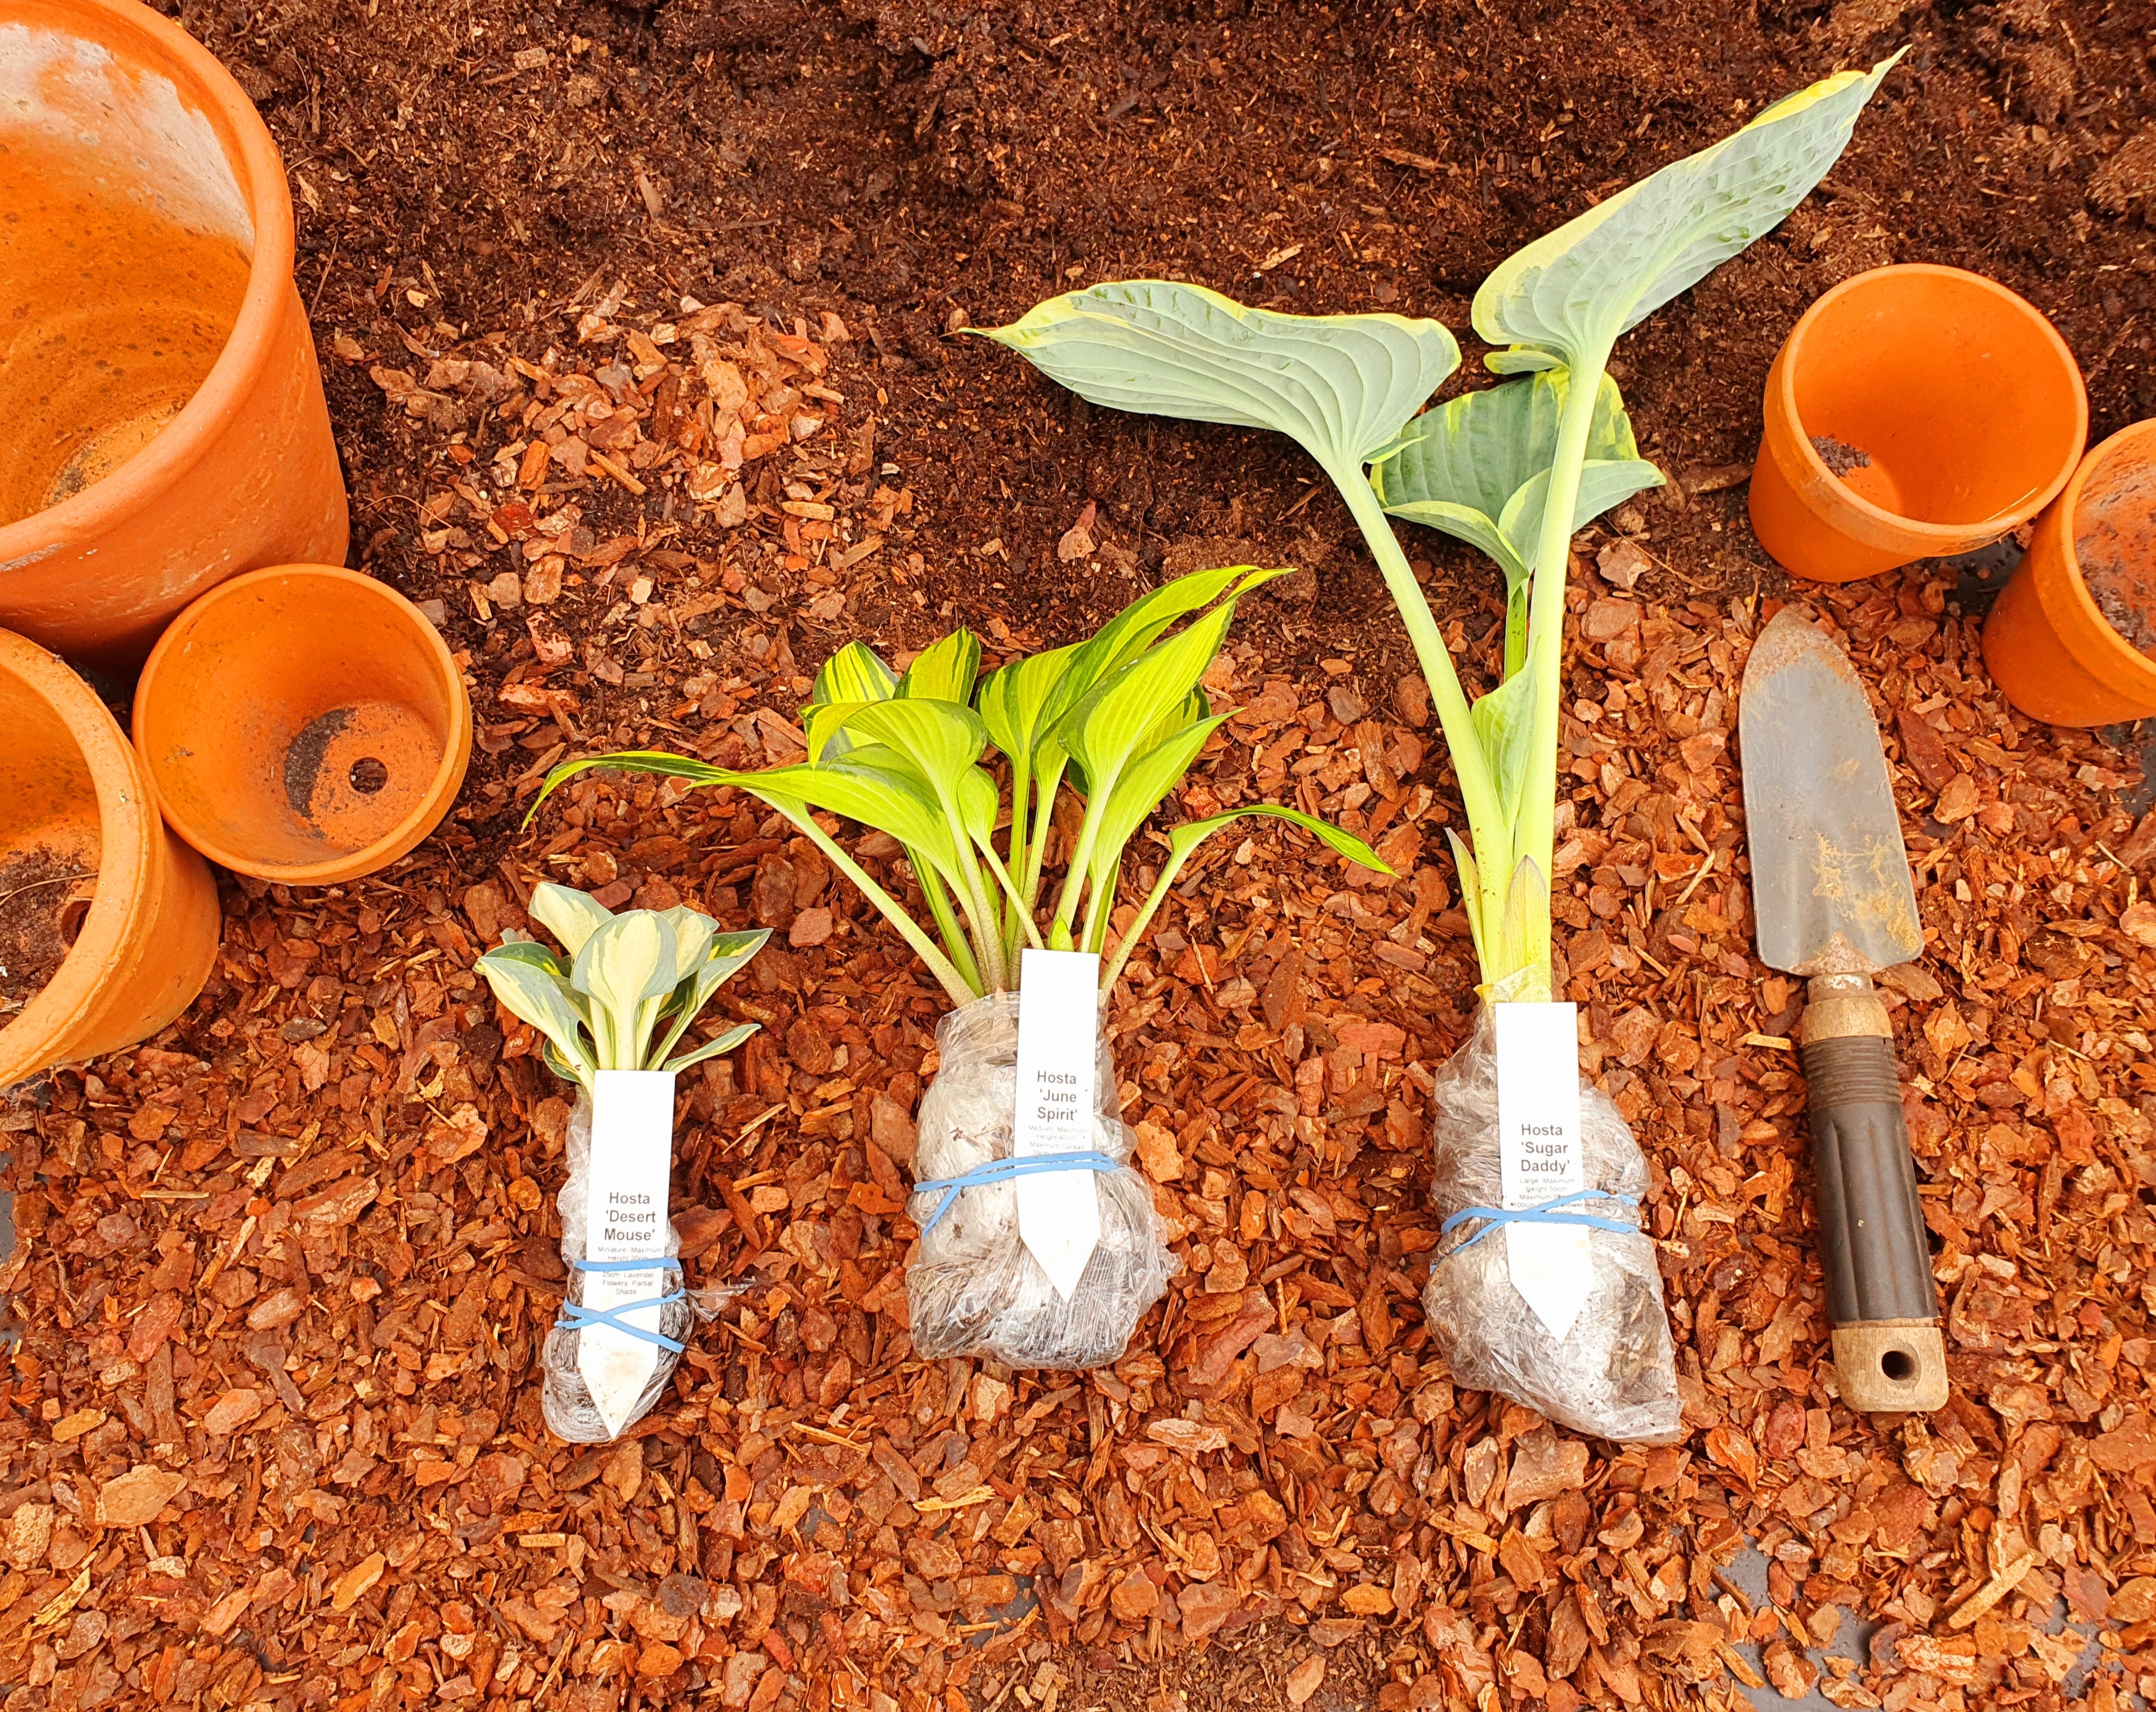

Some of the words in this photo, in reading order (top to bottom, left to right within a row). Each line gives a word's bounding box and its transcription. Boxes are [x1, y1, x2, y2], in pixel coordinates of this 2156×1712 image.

[1037, 1070, 1077, 1084] Hosta
[1040, 1088, 1077, 1102] 'June
[1037, 1106, 1077, 1122] Spirit'
[1521, 1124, 1563, 1136] Hosta
[1522, 1142, 1568, 1156] 'Sugar
[1521, 1159, 1570, 1174] Daddy'
[609, 1192, 650, 1204] Hosta
[606, 1210, 656, 1223] 'Desert
[604, 1228, 655, 1241] Mouse'
